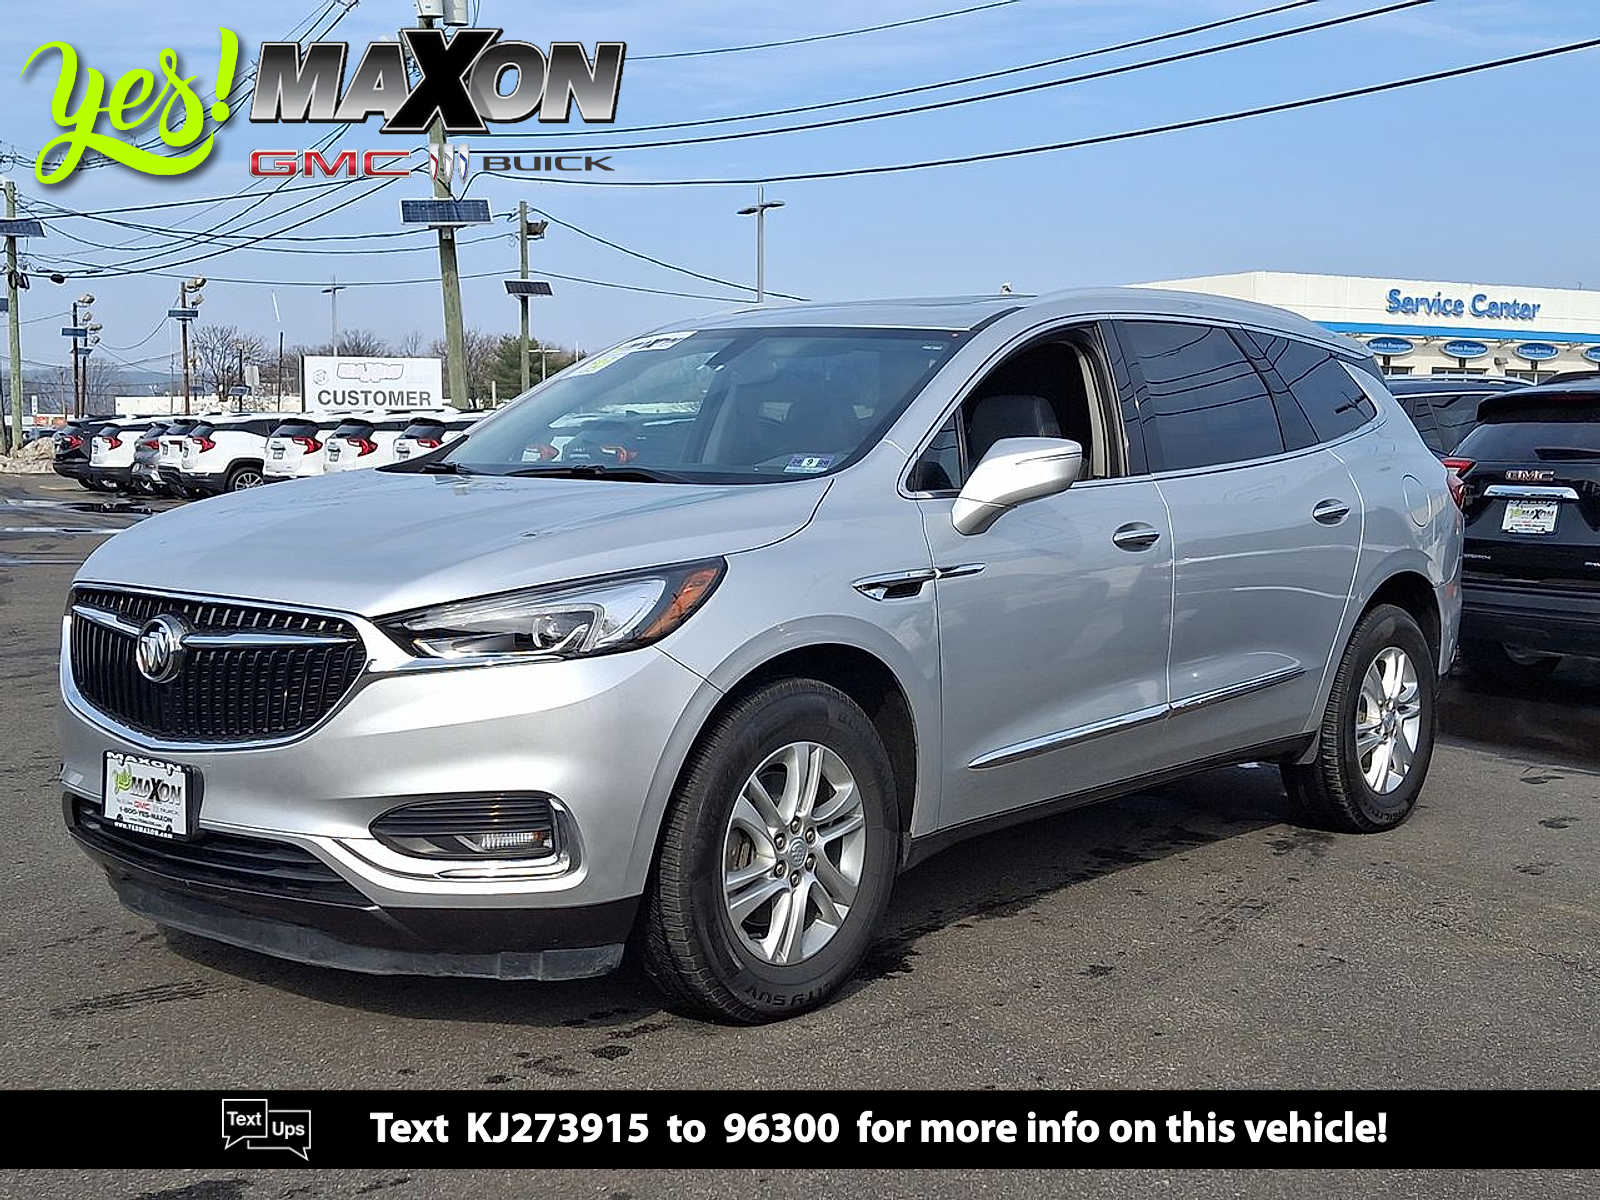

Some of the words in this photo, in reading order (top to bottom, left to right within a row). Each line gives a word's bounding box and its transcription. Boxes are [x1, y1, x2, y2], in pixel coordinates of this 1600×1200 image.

[1386, 288, 1465, 317] Service
[1470, 293, 1541, 321] Center
[317, 389, 431, 407] CUSTOMER
[1505, 470, 1555, 481] GMC
[106, 751, 182, 773] MAXON
[130, 776, 182, 803] MAXON
